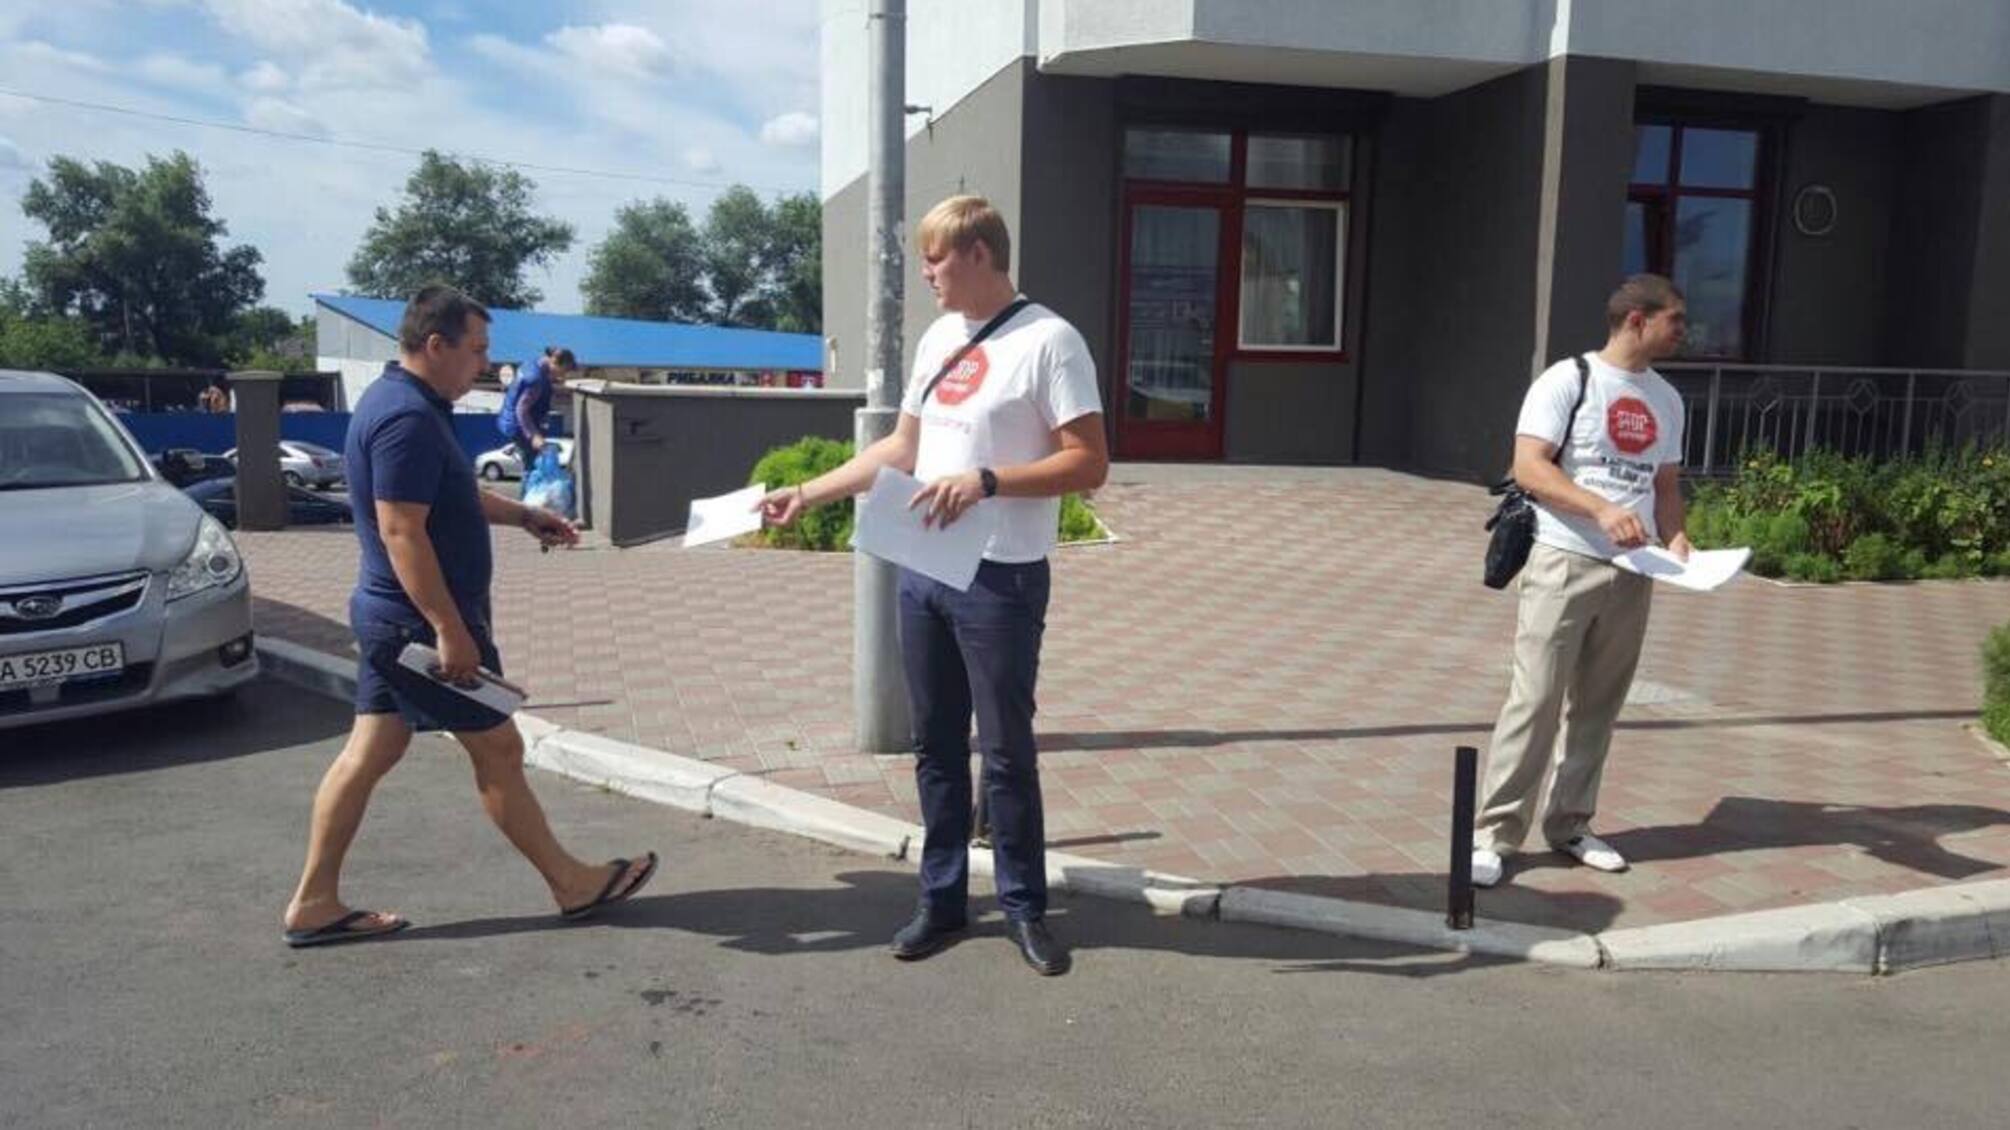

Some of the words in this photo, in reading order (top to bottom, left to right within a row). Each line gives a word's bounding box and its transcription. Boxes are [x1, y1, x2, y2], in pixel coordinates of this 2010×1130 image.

[667, 372, 735, 385] РИБАЛКА
[1617, 410, 1648, 431] STOP
[23, 653, 77, 678] 5239
[83, 648, 117, 670] CB
